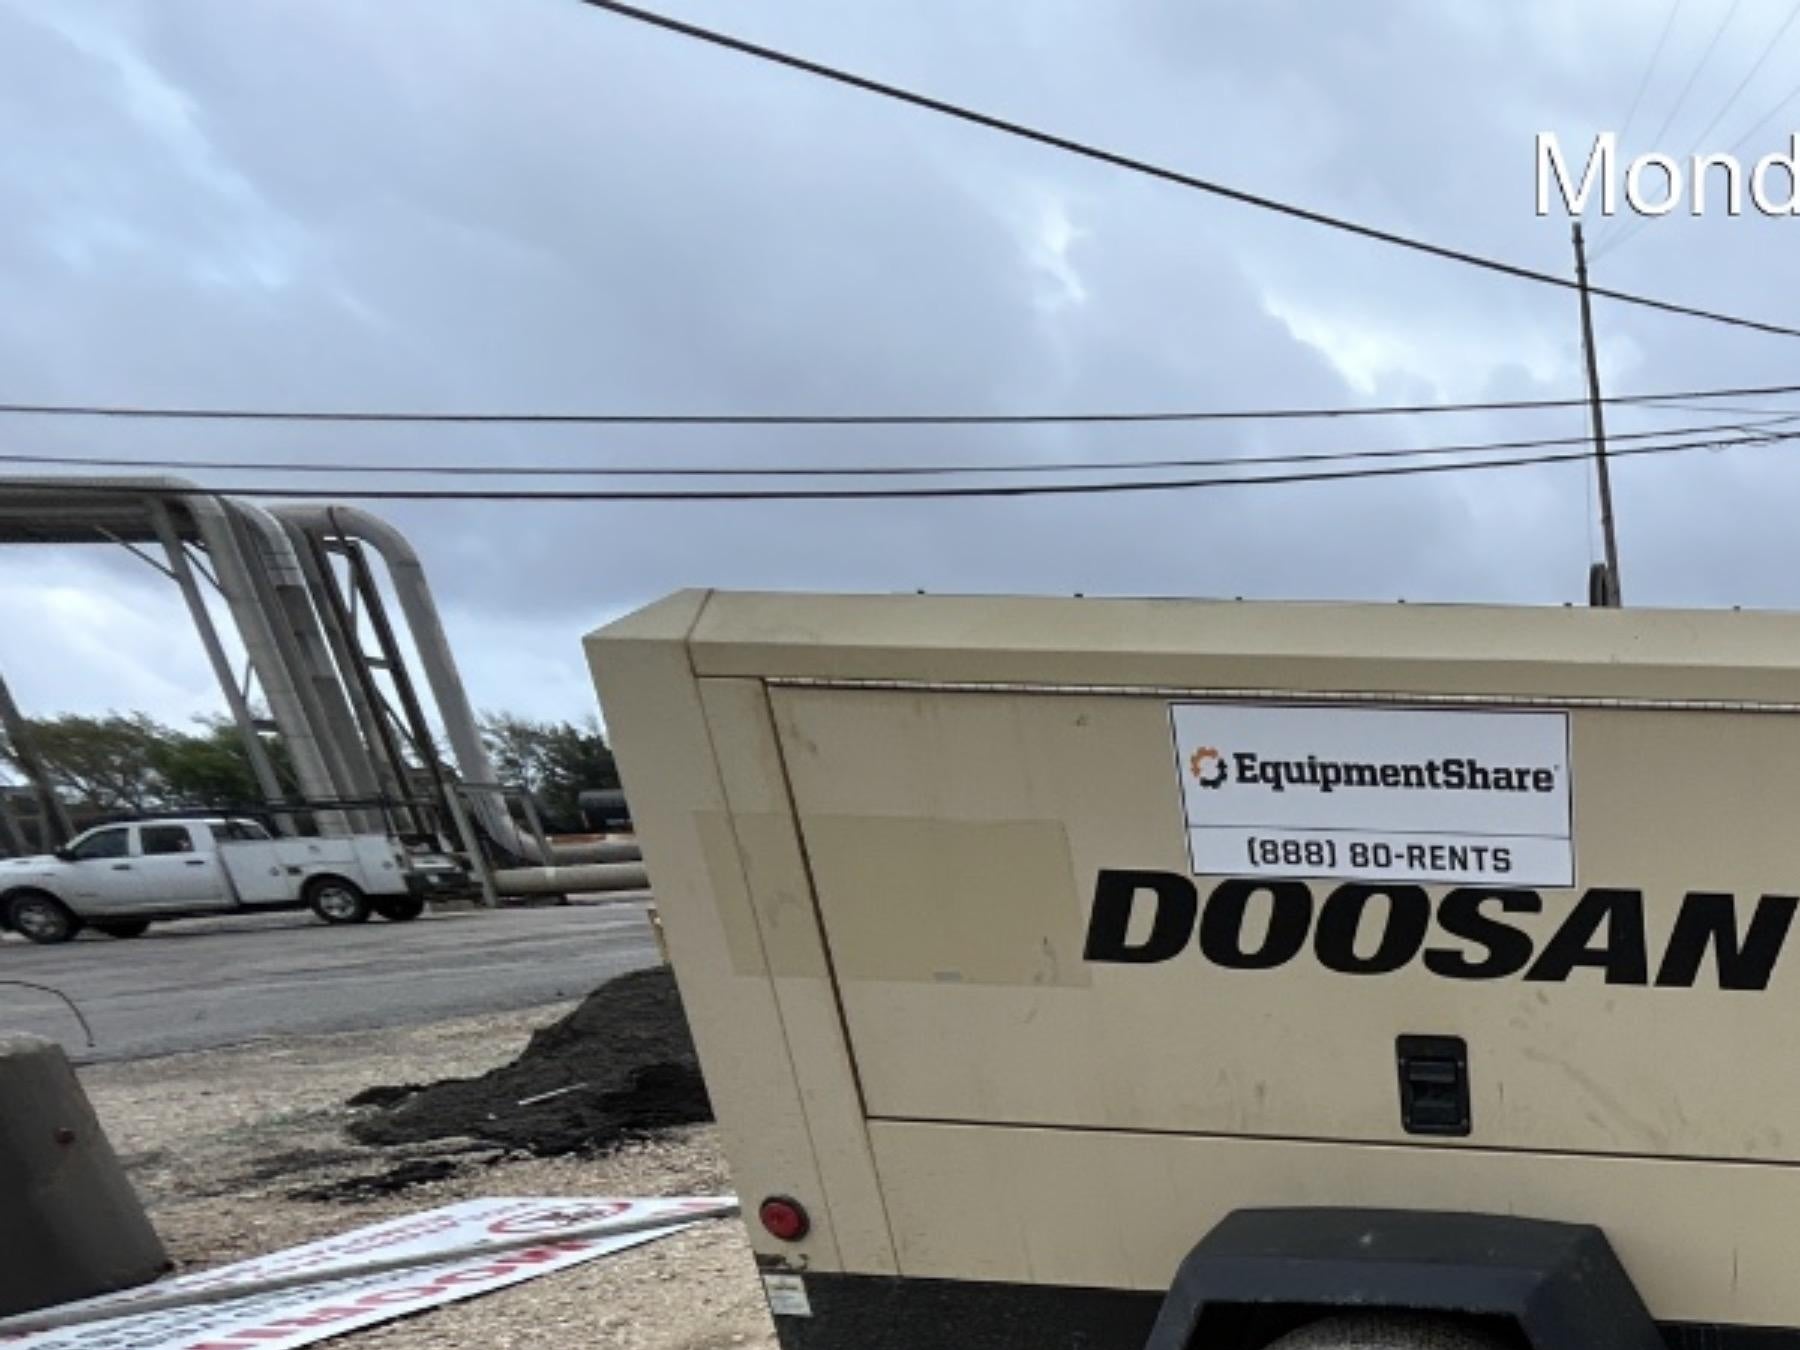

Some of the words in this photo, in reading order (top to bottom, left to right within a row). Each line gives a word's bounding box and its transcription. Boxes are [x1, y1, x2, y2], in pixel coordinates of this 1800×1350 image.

[1233, 752, 1555, 793] EquipmentShare
[1247, 836, 1337, 868] (888)
[1349, 841, 1513, 873] 80-RENTS
[1082, 868, 1800, 991] DOOSAN
